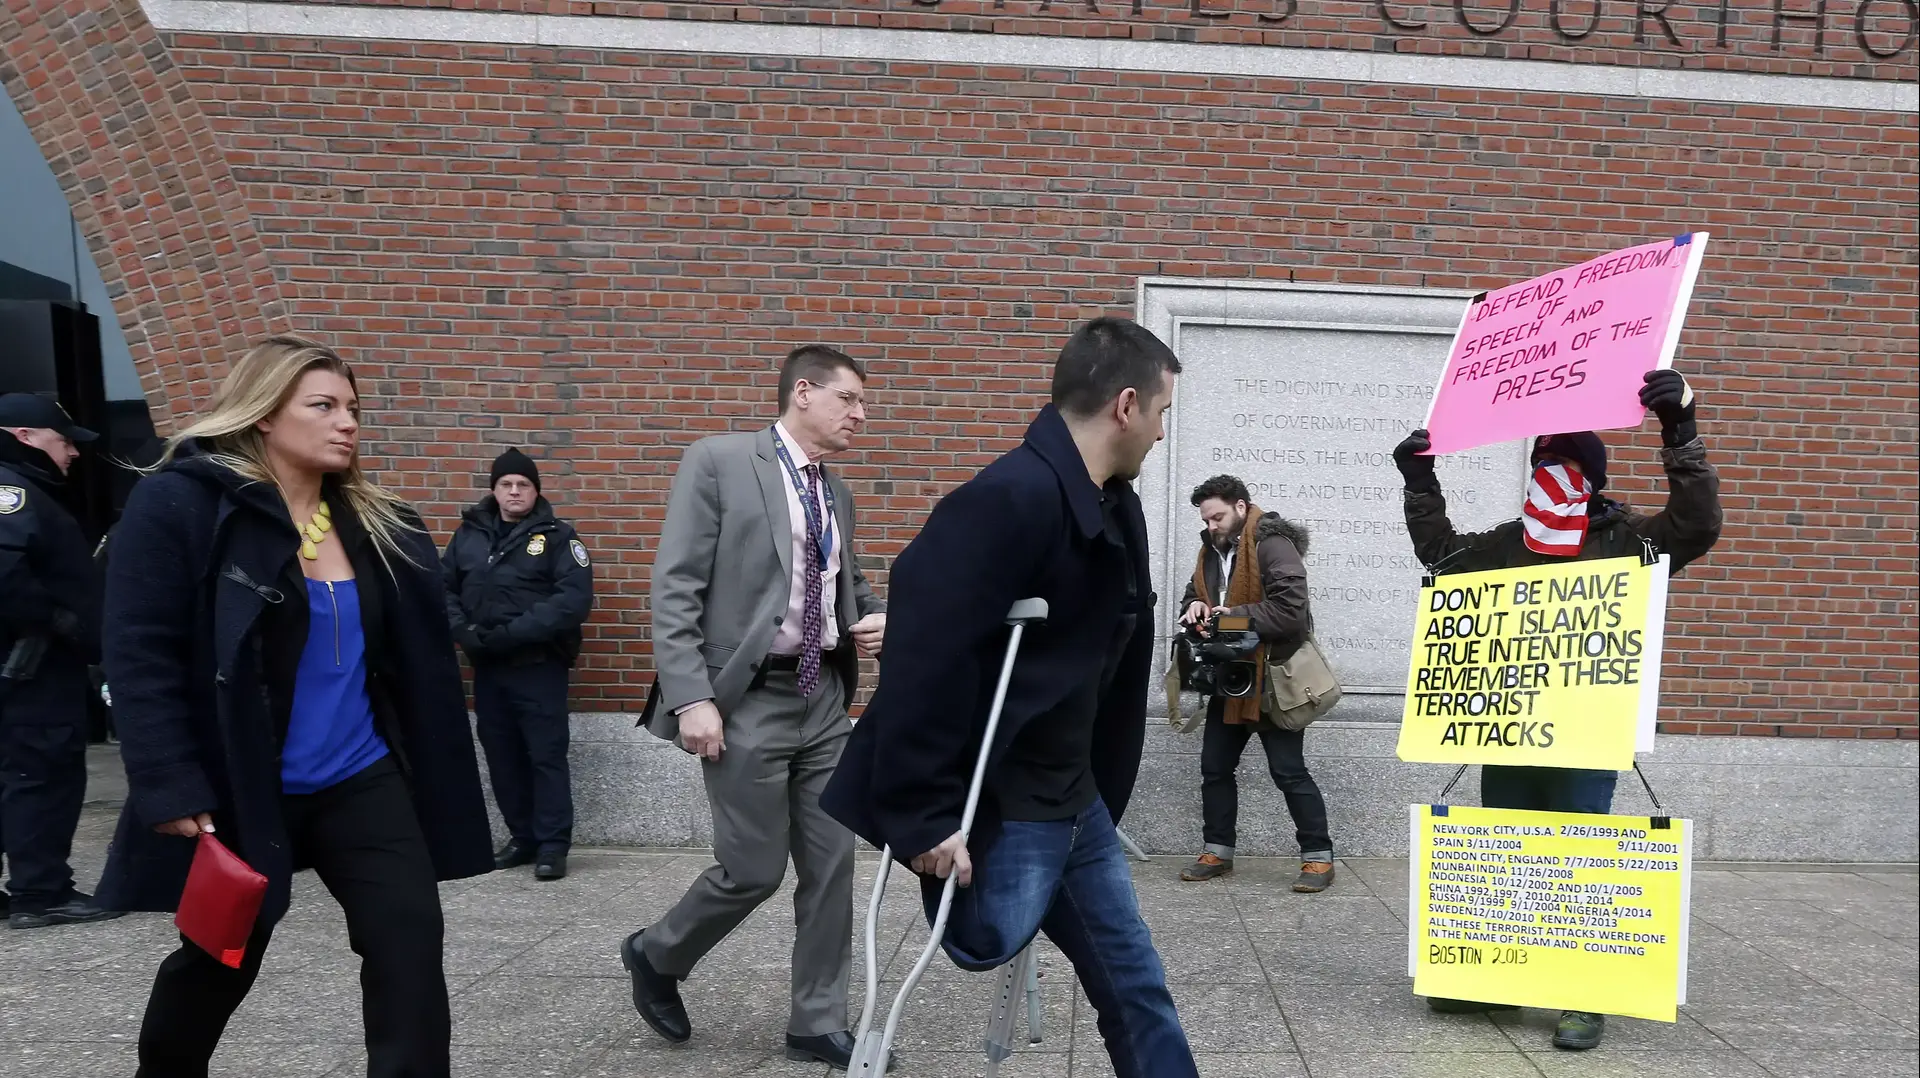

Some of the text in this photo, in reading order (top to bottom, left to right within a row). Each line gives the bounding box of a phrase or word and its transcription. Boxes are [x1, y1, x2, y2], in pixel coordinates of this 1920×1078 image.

[1475, 248, 1673, 322] DEFEND FREEDOM
[1537, 295, 1568, 320] OF
[1461, 299, 1604, 359] SPEECH AND
[1452, 317, 1652, 385] FREEDOM OF THE
[1234, 379, 1268, 394] THE
[1352, 383, 1390, 398] AND
[1492, 359, 1588, 405] PRESS
[1233, 413, 1258, 428] OF
[1262, 413, 1389, 432] GOVERNMENT
[1392, 418, 1410, 433] IN
[1211, 447, 1309, 467] BRANCHES,
[1314, 450, 1348, 466] THE
[1461, 455, 1491, 471] THE
[1297, 484, 1336, 500] AND
[1343, 486, 1394, 501] EVERY
[1345, 554, 1384, 569] AND
[1377, 589, 1401, 603] OF
[1430, 572, 1630, 612] DON'T BE NAIVE
[1424, 601, 1622, 640] ABOUT ISLAM'S
[1424, 630, 1642, 666] TRUE INTENTIONS
[1416, 658, 1640, 691] REMEMBER THESE
[1414, 690, 1540, 716] TERRORIST
[1440, 722, 1554, 748] ATTACKS
[1432, 837, 1522, 850] SPAIN 3/11/2004
[1433, 824, 1647, 839] NEW YORK CITY, U.S.A. 2/26/1993 AND
[1617, 840, 1678, 853] 9/11/2001
[1431, 850, 1678, 871] LONDON CITY, ENGLAND 7/7/2005 5/22/2013
[1510, 866, 1574, 879] 11/26/2008
[1428, 883, 1461, 893] CHINA
[1586, 896, 1613, 905] 2014
[1429, 871, 1643, 896] INDONESIA 10/12/2002 AND 10/1/2005
[1429, 892, 1652, 918] RUSSIA 9/1999 9/1/2004 NIGERIA 4/2014
[1429, 917, 1666, 944] ALL THESE TERRORIST ATTACKS WERE DONE
[1540, 914, 1577, 925] KENYA
[1579, 916, 1618, 928] 9/2013
[1428, 928, 1645, 956] IN THE NAME OF ISLAM AND COUNTING
[1429, 944, 1528, 964] BOSTON 2013
